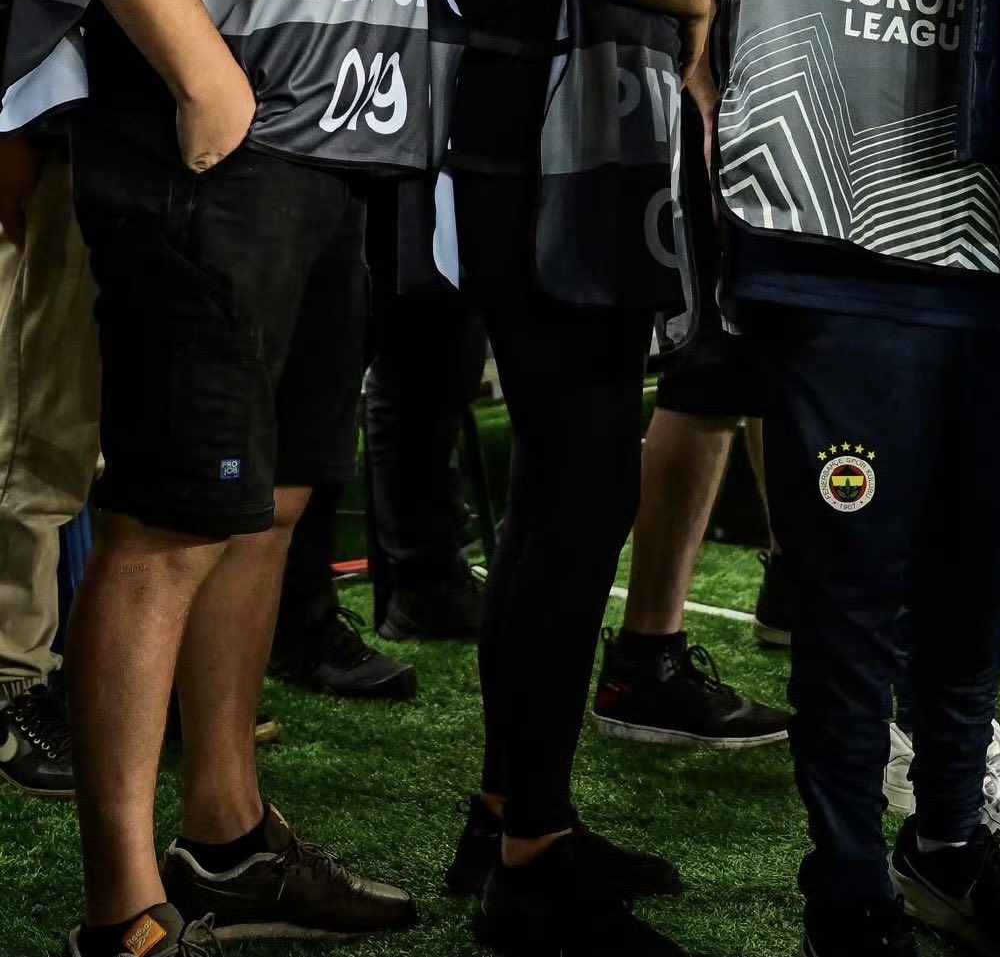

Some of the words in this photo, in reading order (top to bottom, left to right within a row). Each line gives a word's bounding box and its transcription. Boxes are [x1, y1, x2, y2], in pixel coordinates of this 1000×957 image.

[844, 8, 960, 51] LEAGU
[319, 48, 408, 135] 019
[840, 503, 856, 511] 1907
